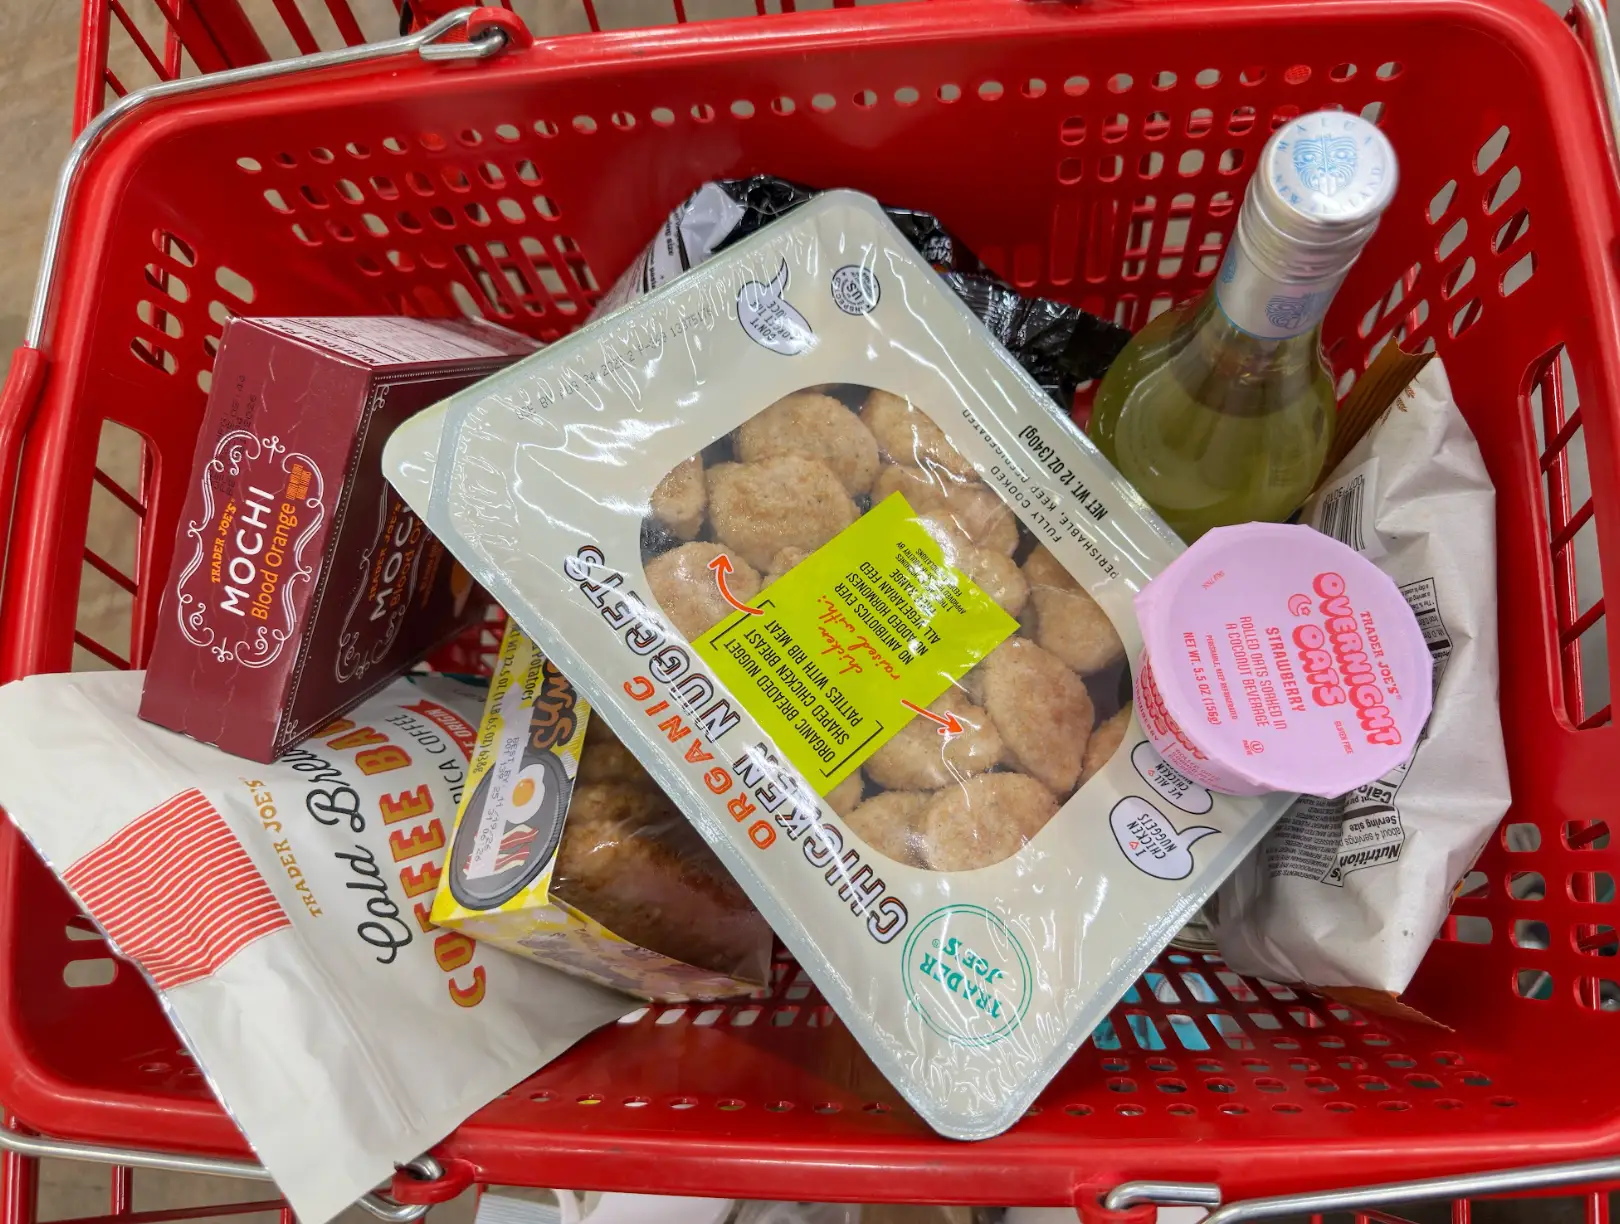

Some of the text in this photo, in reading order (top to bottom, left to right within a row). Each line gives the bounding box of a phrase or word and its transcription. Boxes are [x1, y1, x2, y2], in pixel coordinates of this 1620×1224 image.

[1017, 423, 1109, 521] NET WT. 12 OZ (340g)
[1029, 483, 1057, 513] KEEP
[988, 464, 1064, 544] FULLY COOKED
[210, 502, 237, 584] TRADER JOE'S
[219, 485, 276, 617] MOCHI
[248, 569, 279, 621] Blood
[264, 503, 297, 569] Orange
[370, 505, 415, 620] MOC
[859, 558, 886, 584] FEED
[1055, 511, 1121, 581] PERISHABLE,
[876, 578, 927, 631] VEGETARIAN
[889, 568, 918, 596] RANGE
[559, 538, 746, 743] NUGGETS
[811, 625, 862, 680] chicken
[817, 594, 901, 684] raised with:
[833, 580, 916, 667] NO ANTIBIOTICS EVER
[884, 611, 919, 646] ADDED
[919, 625, 943, 647] ALL
[1360, 610, 1399, 696] TRADER JOE'S
[497, 677, 508, 692] OZ
[500, 655, 514, 678] 22.5
[521, 652, 543, 702] Potatoes
[742, 625, 851, 748] SHAPED CHICKEN BREAST
[763, 616, 865, 730] PATTIES WITH RIB MEAT
[1182, 630, 1223, 727] NET WT. 5.5 OZ (156g)
[1225, 622, 1270, 728] A COCONUT BEVERAGE
[1239, 615, 1288, 731] ROLLED OATS SOAKED IN
[1265, 625, 1307, 715] STRAWBERRY
[1291, 621, 1348, 710] OATS
[1312, 573, 1403, 746] OVERNIGHT
[425, 707, 472, 738] ORIGIN
[722, 635, 838, 765] ORGANIC BREADED NUGGET
[384, 713, 447, 755] COFFEE
[474, 749, 489, 776] 638g
[480, 732, 494, 751] OZ)
[620, 670, 780, 853] ORGANIC
[1333, 719, 1354, 755] GLUTEN FREE
[1153, 774, 1171, 789] ALL
[1156, 762, 1189, 792] CHICKEN
[1168, 787, 1184, 800] WE
[245, 778, 324, 917] TRADER JOE'S
[728, 739, 916, 948] CHICKEN
[1126, 820, 1167, 861] CHICKEN
[1137, 812, 1178, 854] NUGGETS
[1344, 831, 1374, 847] servings
[1349, 822, 1365, 833] size
[1365, 815, 1397, 829] Serving
[1380, 826, 1401, 841] about
[1339, 843, 1400, 871] Nutrition
[335, 844, 413, 965] Cold
[917, 954, 1004, 1019] TRADER
